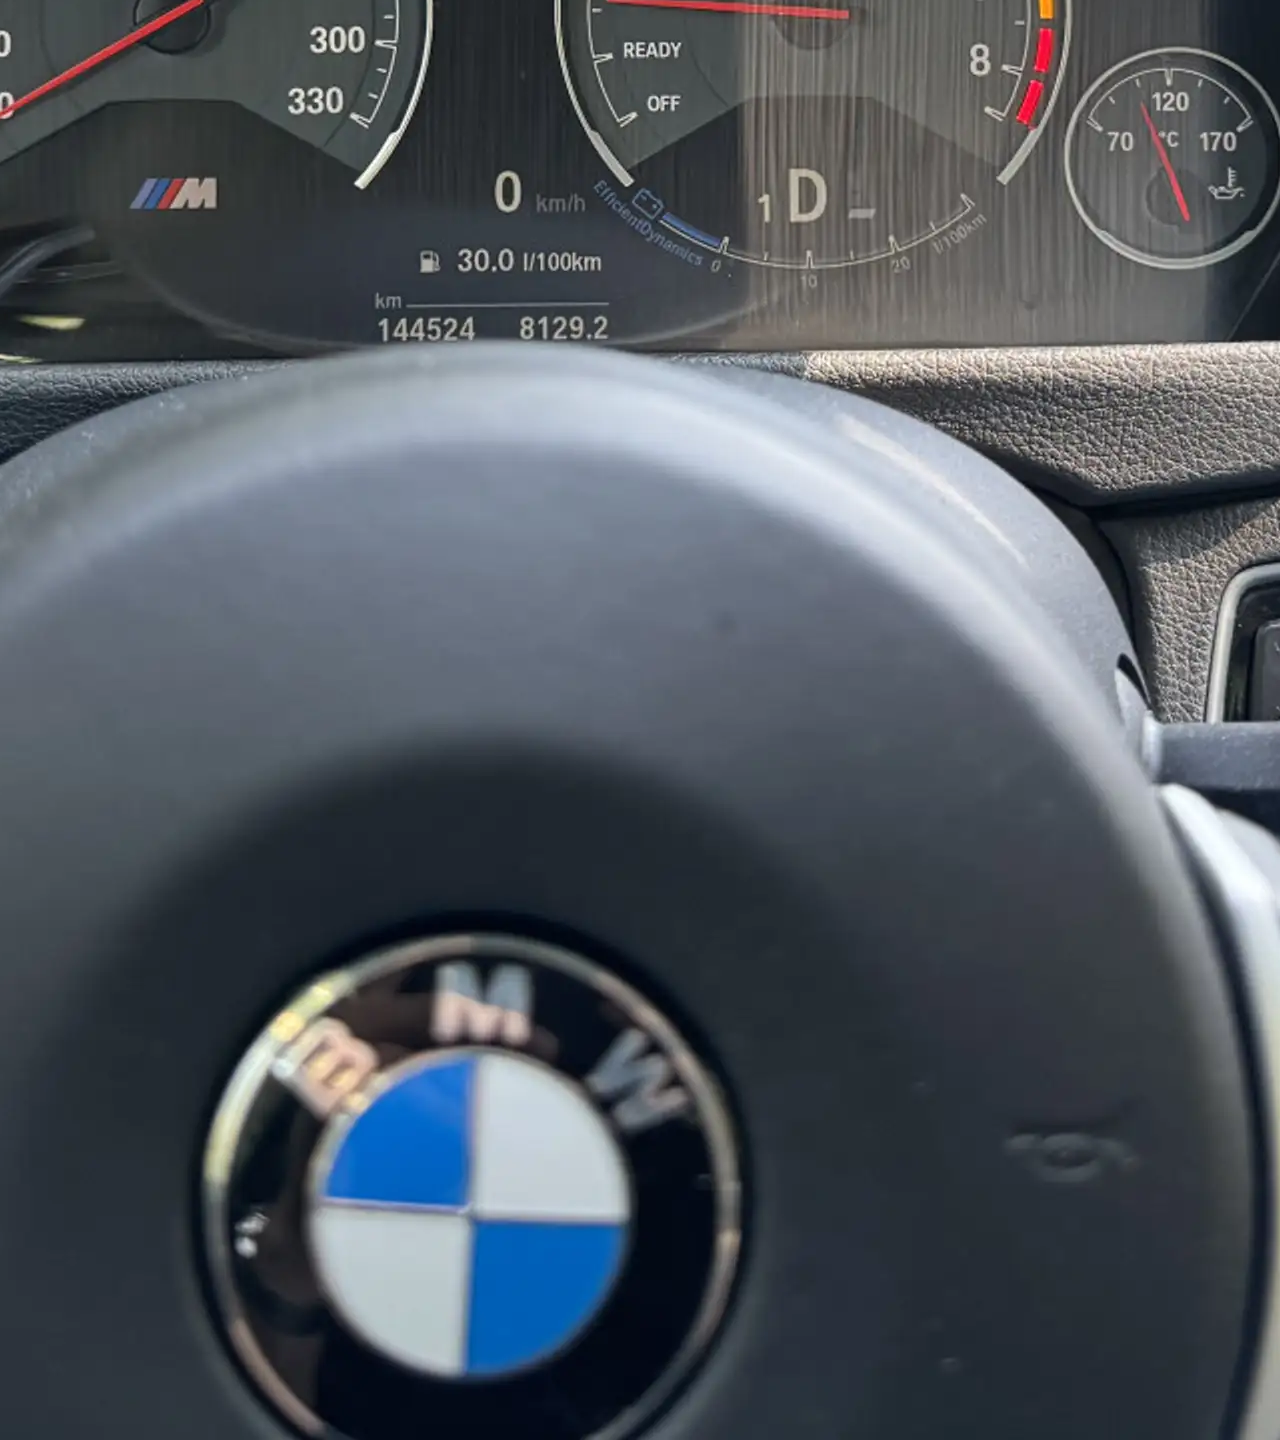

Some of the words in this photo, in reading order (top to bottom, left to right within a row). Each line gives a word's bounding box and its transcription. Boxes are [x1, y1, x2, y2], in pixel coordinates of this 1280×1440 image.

[309, 26, 366, 54] 300
[623, 42, 682, 60] READY
[969, 44, 991, 77] 8
[287, 87, 344, 115] 330
[647, 96, 681, 113] OFF
[1151, 92, 1189, 112] 120
[1108, 132, 1134, 152] 70
[1200, 132, 1236, 152] 170
[169, 177, 217, 209] M
[495, 170, 522, 212] 0
[536, 194, 586, 212] km/h
[758, 194, 771, 223] 1
[789, 168, 827, 223] D
[593, 180, 704, 266] EfficientDynamics
[932, 213, 987, 255] l/100km
[457, 248, 514, 272] 30.0
[523, 251, 602, 272] l/100km
[710, 259, 721, 273] 0
[891, 256, 911, 274] 20
[800, 274, 818, 289] 10
[375, 292, 402, 309] km
[378, 317, 476, 342] 144524
[520, 316, 608, 340] 8129.2
[269, 961, 695, 1132] BMW
